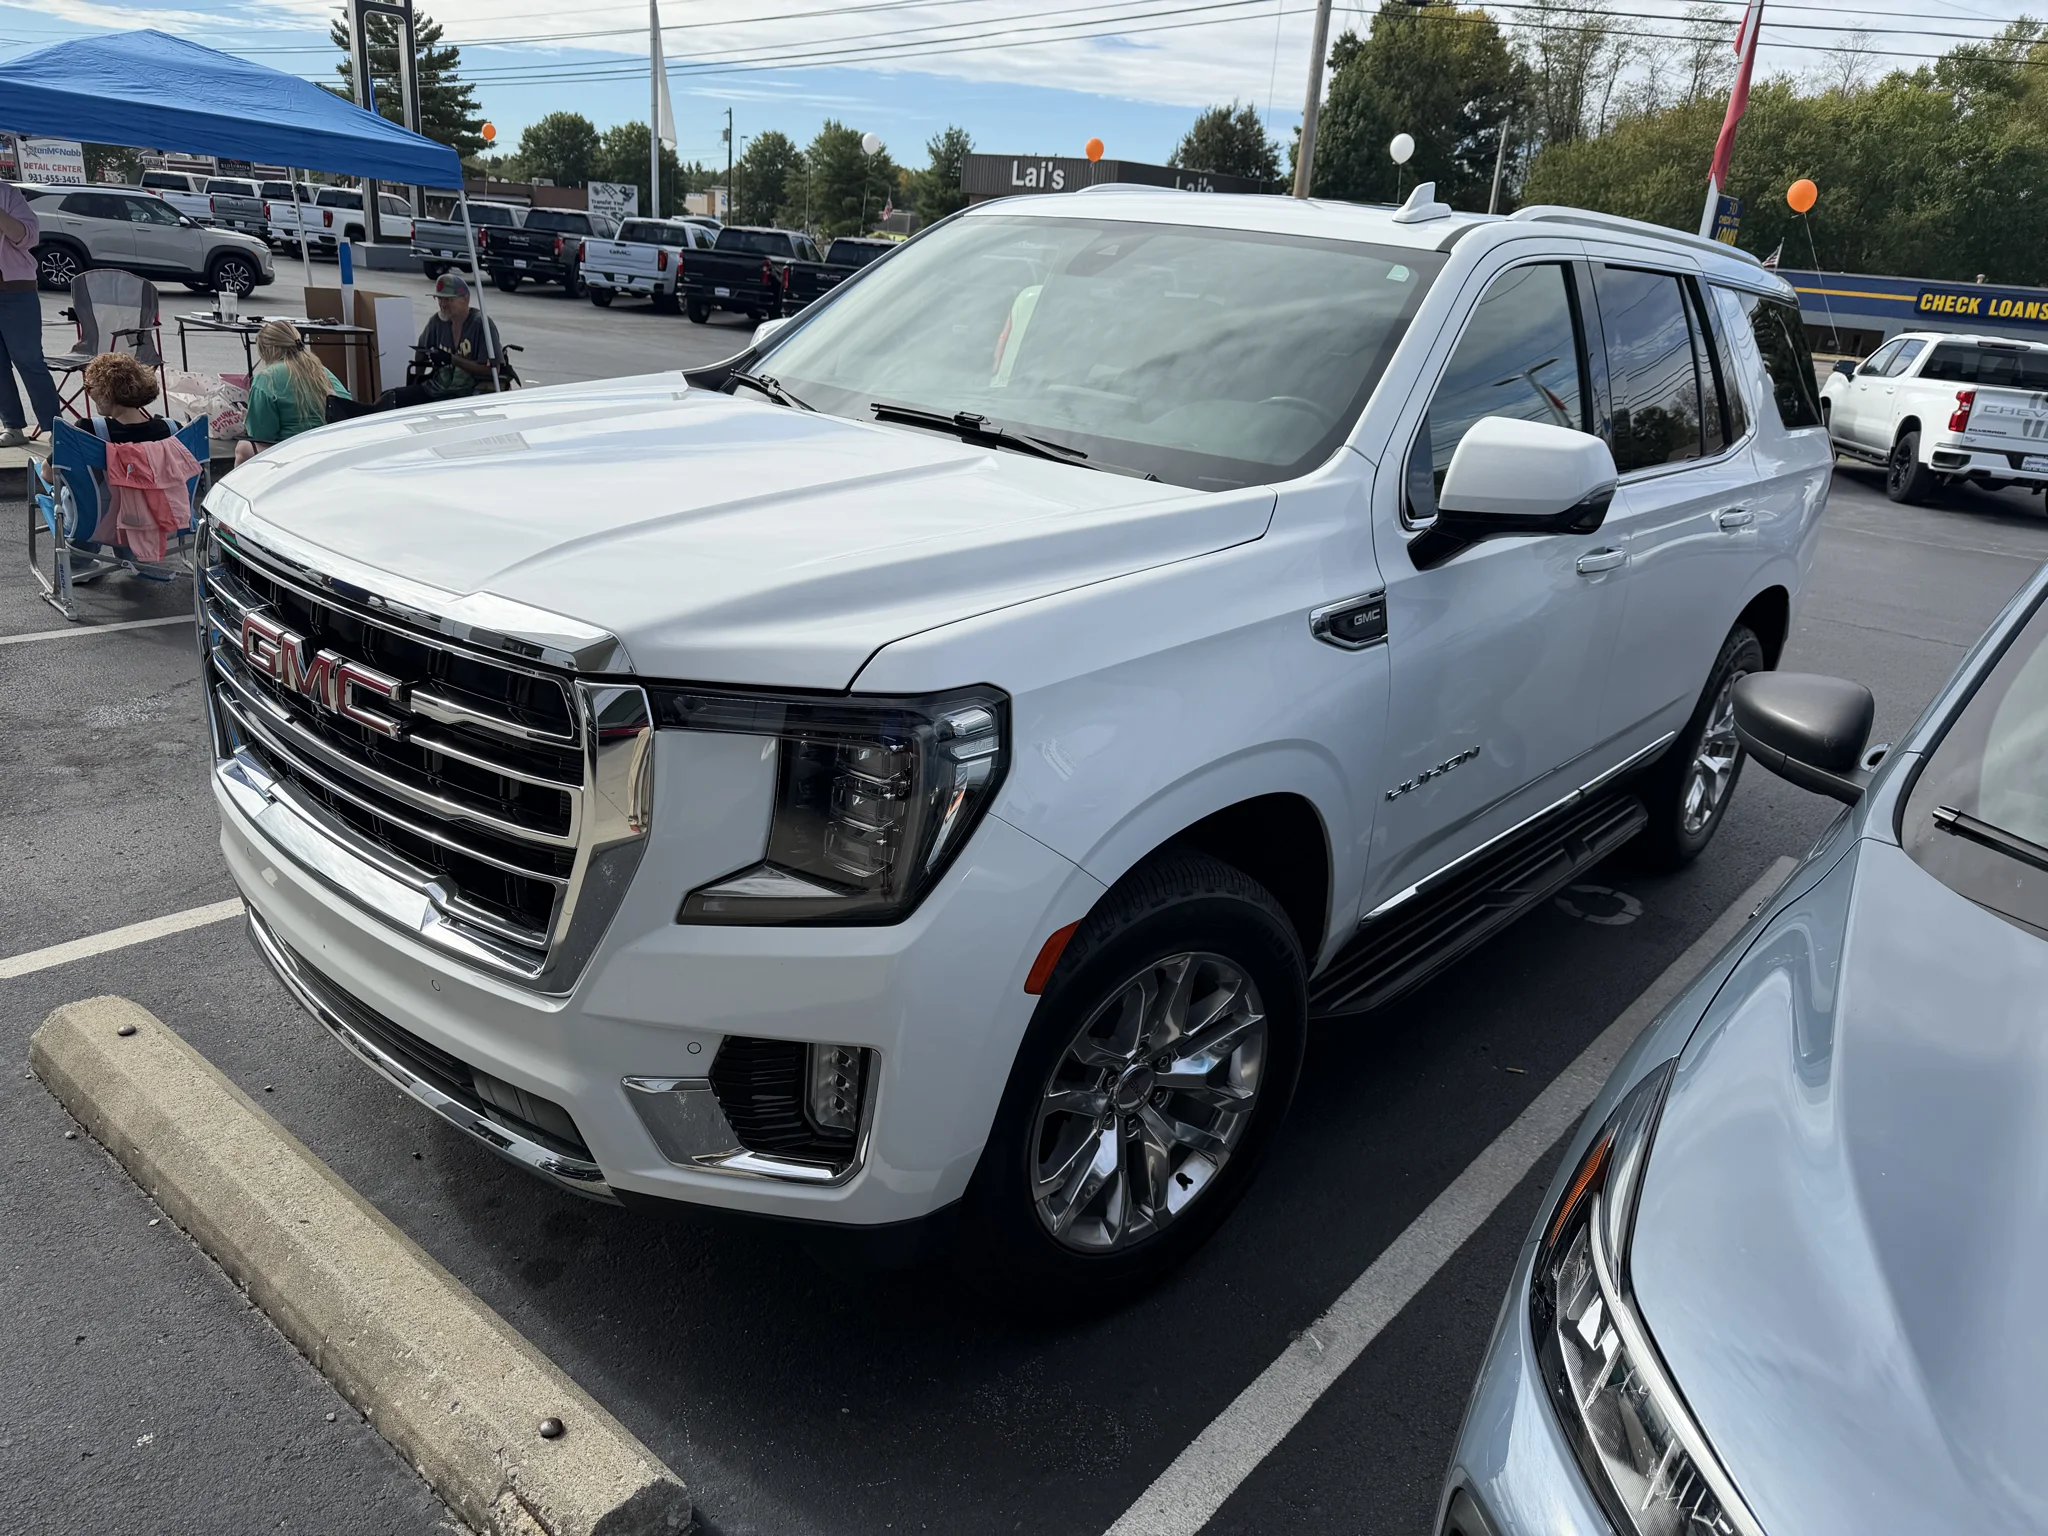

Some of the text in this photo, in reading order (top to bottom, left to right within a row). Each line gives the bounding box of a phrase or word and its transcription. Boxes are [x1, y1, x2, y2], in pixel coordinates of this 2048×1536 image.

[23, 162, 82, 173] DETAIL CENTER
[1011, 160, 1065, 190] Lai's
[28, 173, 81, 184] 931-455-3451
[1920, 293, 2048, 320] CHECK LOANS
[214, 418, 234, 434] WITH
[1353, 608, 1381, 626] GMC
[242, 612, 402, 742] GMC
